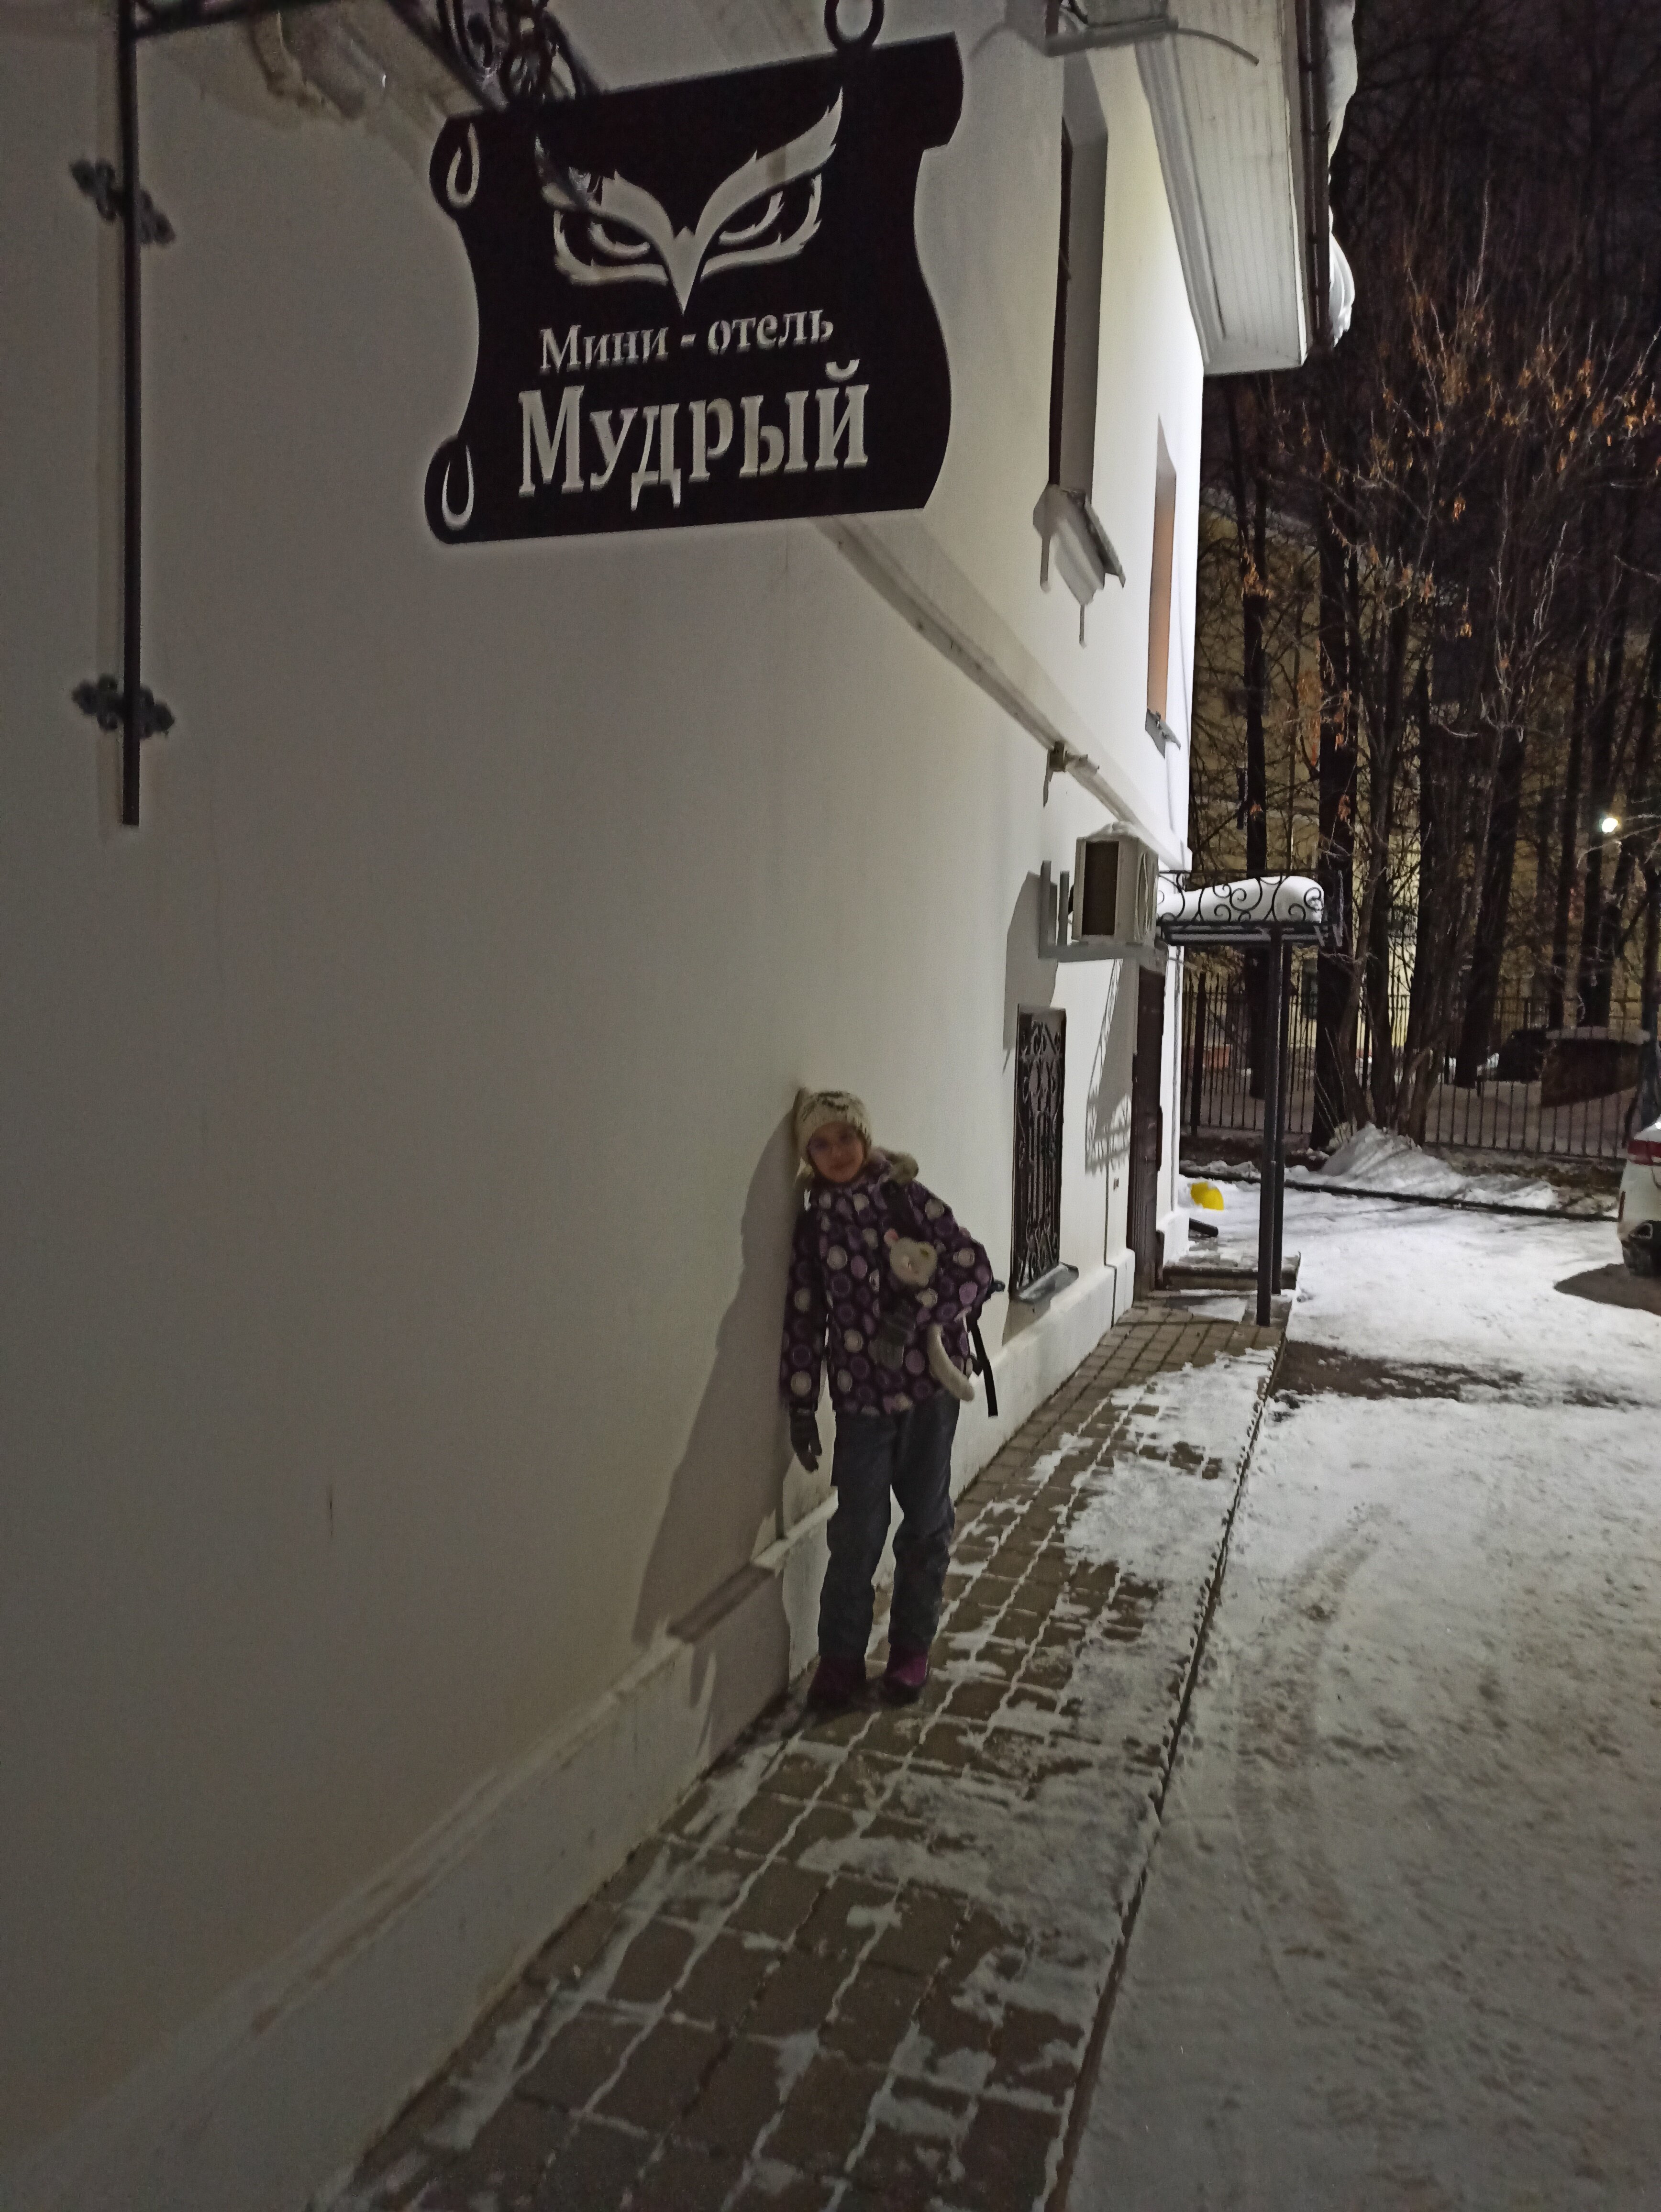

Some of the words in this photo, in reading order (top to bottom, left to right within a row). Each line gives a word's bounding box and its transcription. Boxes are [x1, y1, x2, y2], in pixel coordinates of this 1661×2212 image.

[540, 325, 669, 375] Мини
[708, 309, 834, 354] отель
[518, 358, 870, 511] Мудрый
